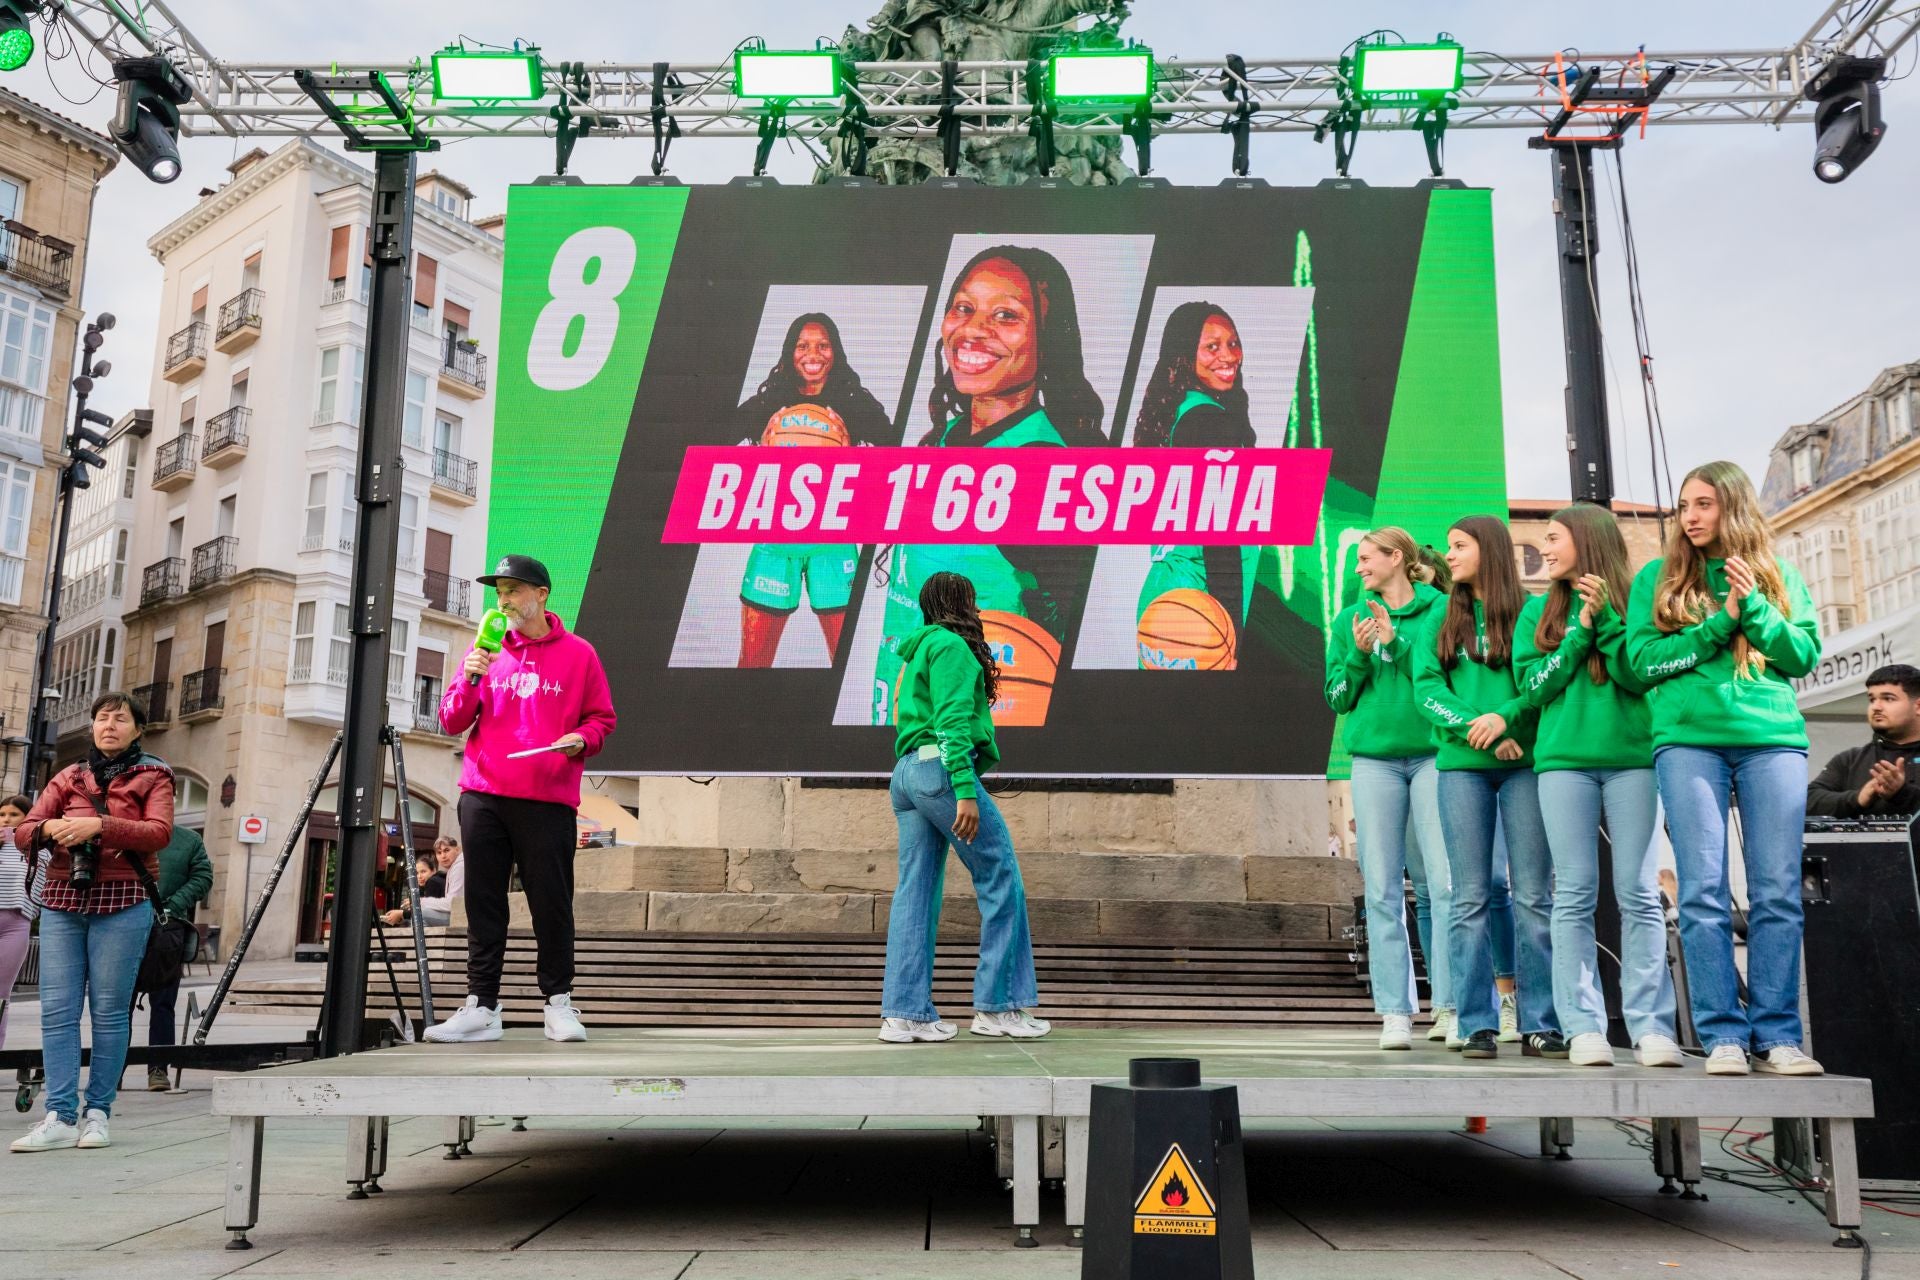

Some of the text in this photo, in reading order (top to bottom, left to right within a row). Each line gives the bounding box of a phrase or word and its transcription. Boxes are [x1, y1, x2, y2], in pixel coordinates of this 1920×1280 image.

[527, 226, 637, 391] 8
[697, 449, 1277, 532] BASE 1'68 ESPAÑA
[1646, 652, 1698, 677] ARASKI
[1795, 632, 1894, 693] xabank
[1423, 696, 1463, 725] ARASKI
[1140, 1220, 1209, 1228] FLAMMBLE
